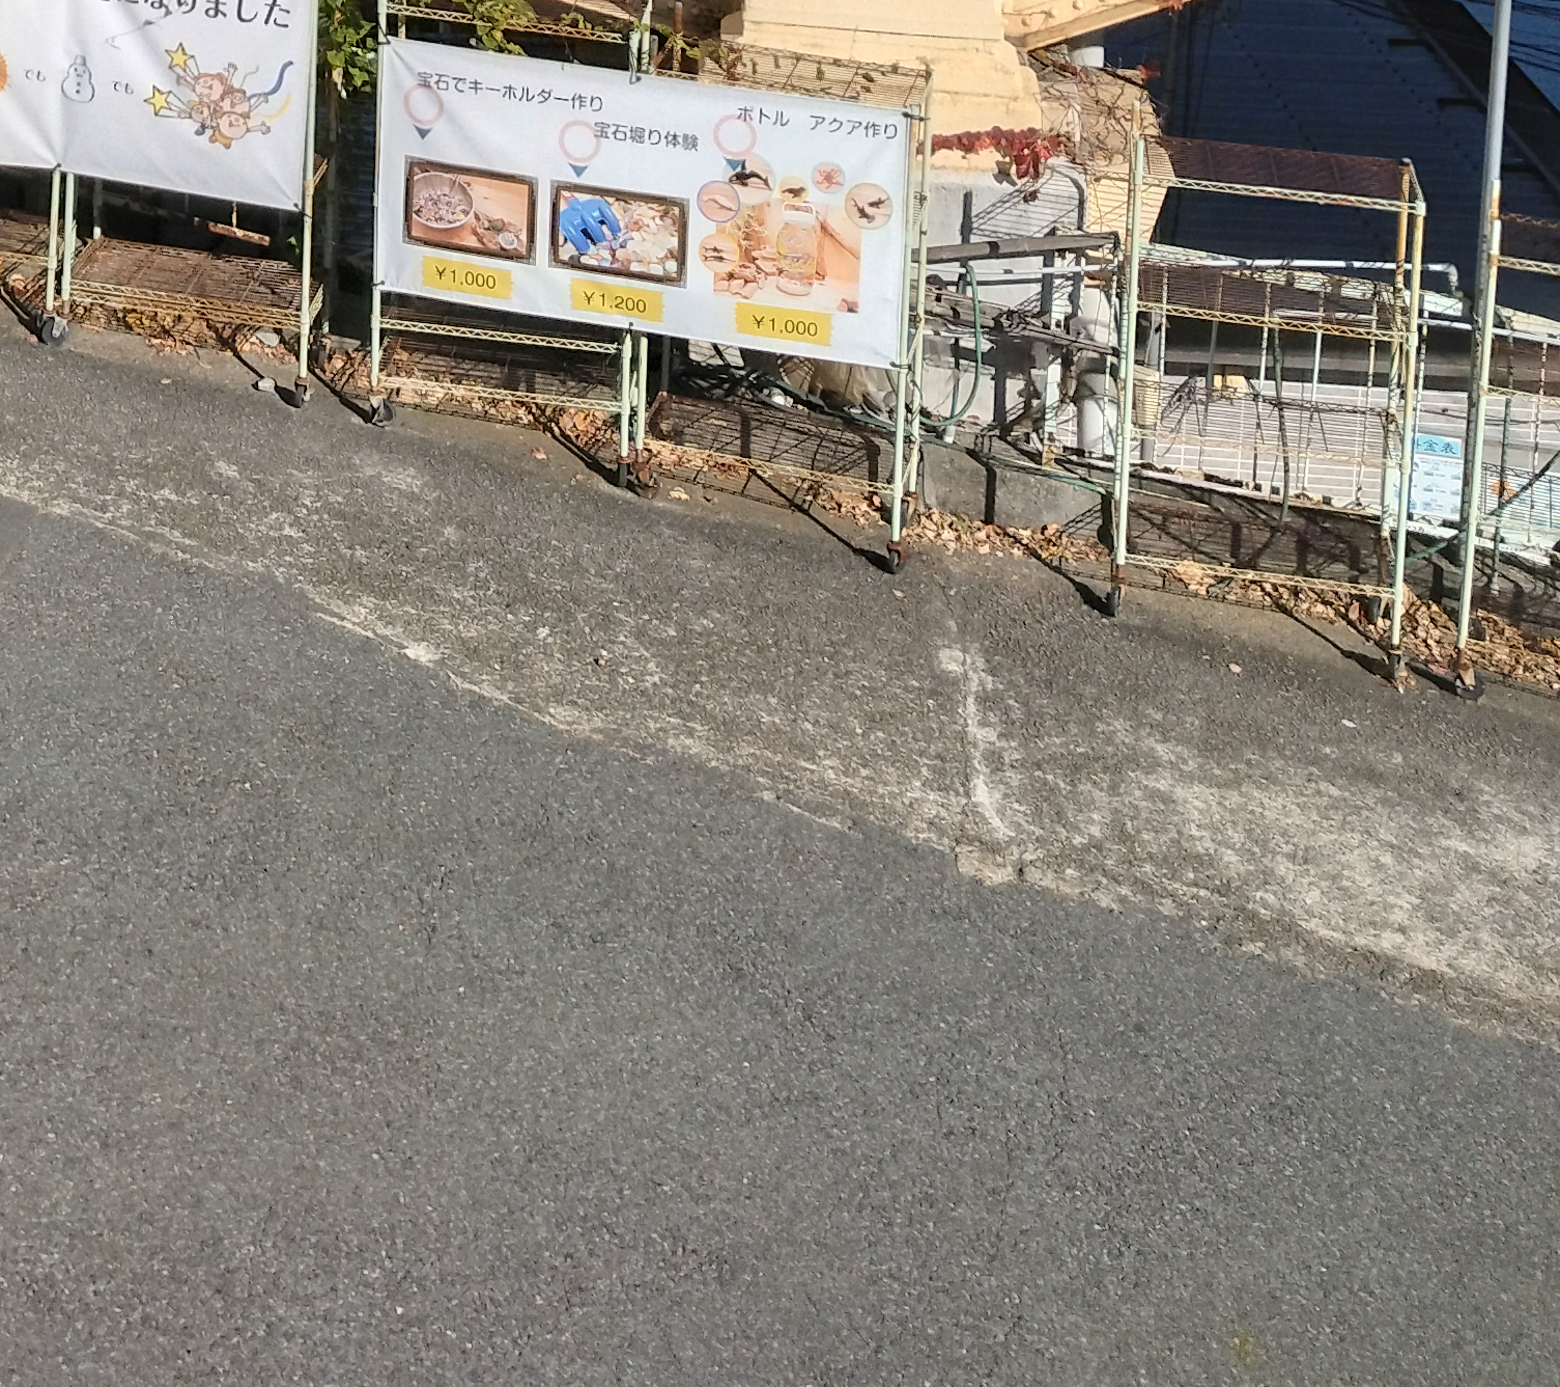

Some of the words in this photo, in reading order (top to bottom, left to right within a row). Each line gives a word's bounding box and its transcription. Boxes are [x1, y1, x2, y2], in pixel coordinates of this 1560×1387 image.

[417, 71, 604, 113] 宝石でキーホルダー作り
[809, 114, 898, 140] アクア作り
[1415, 437, 1458, 455] 金表
